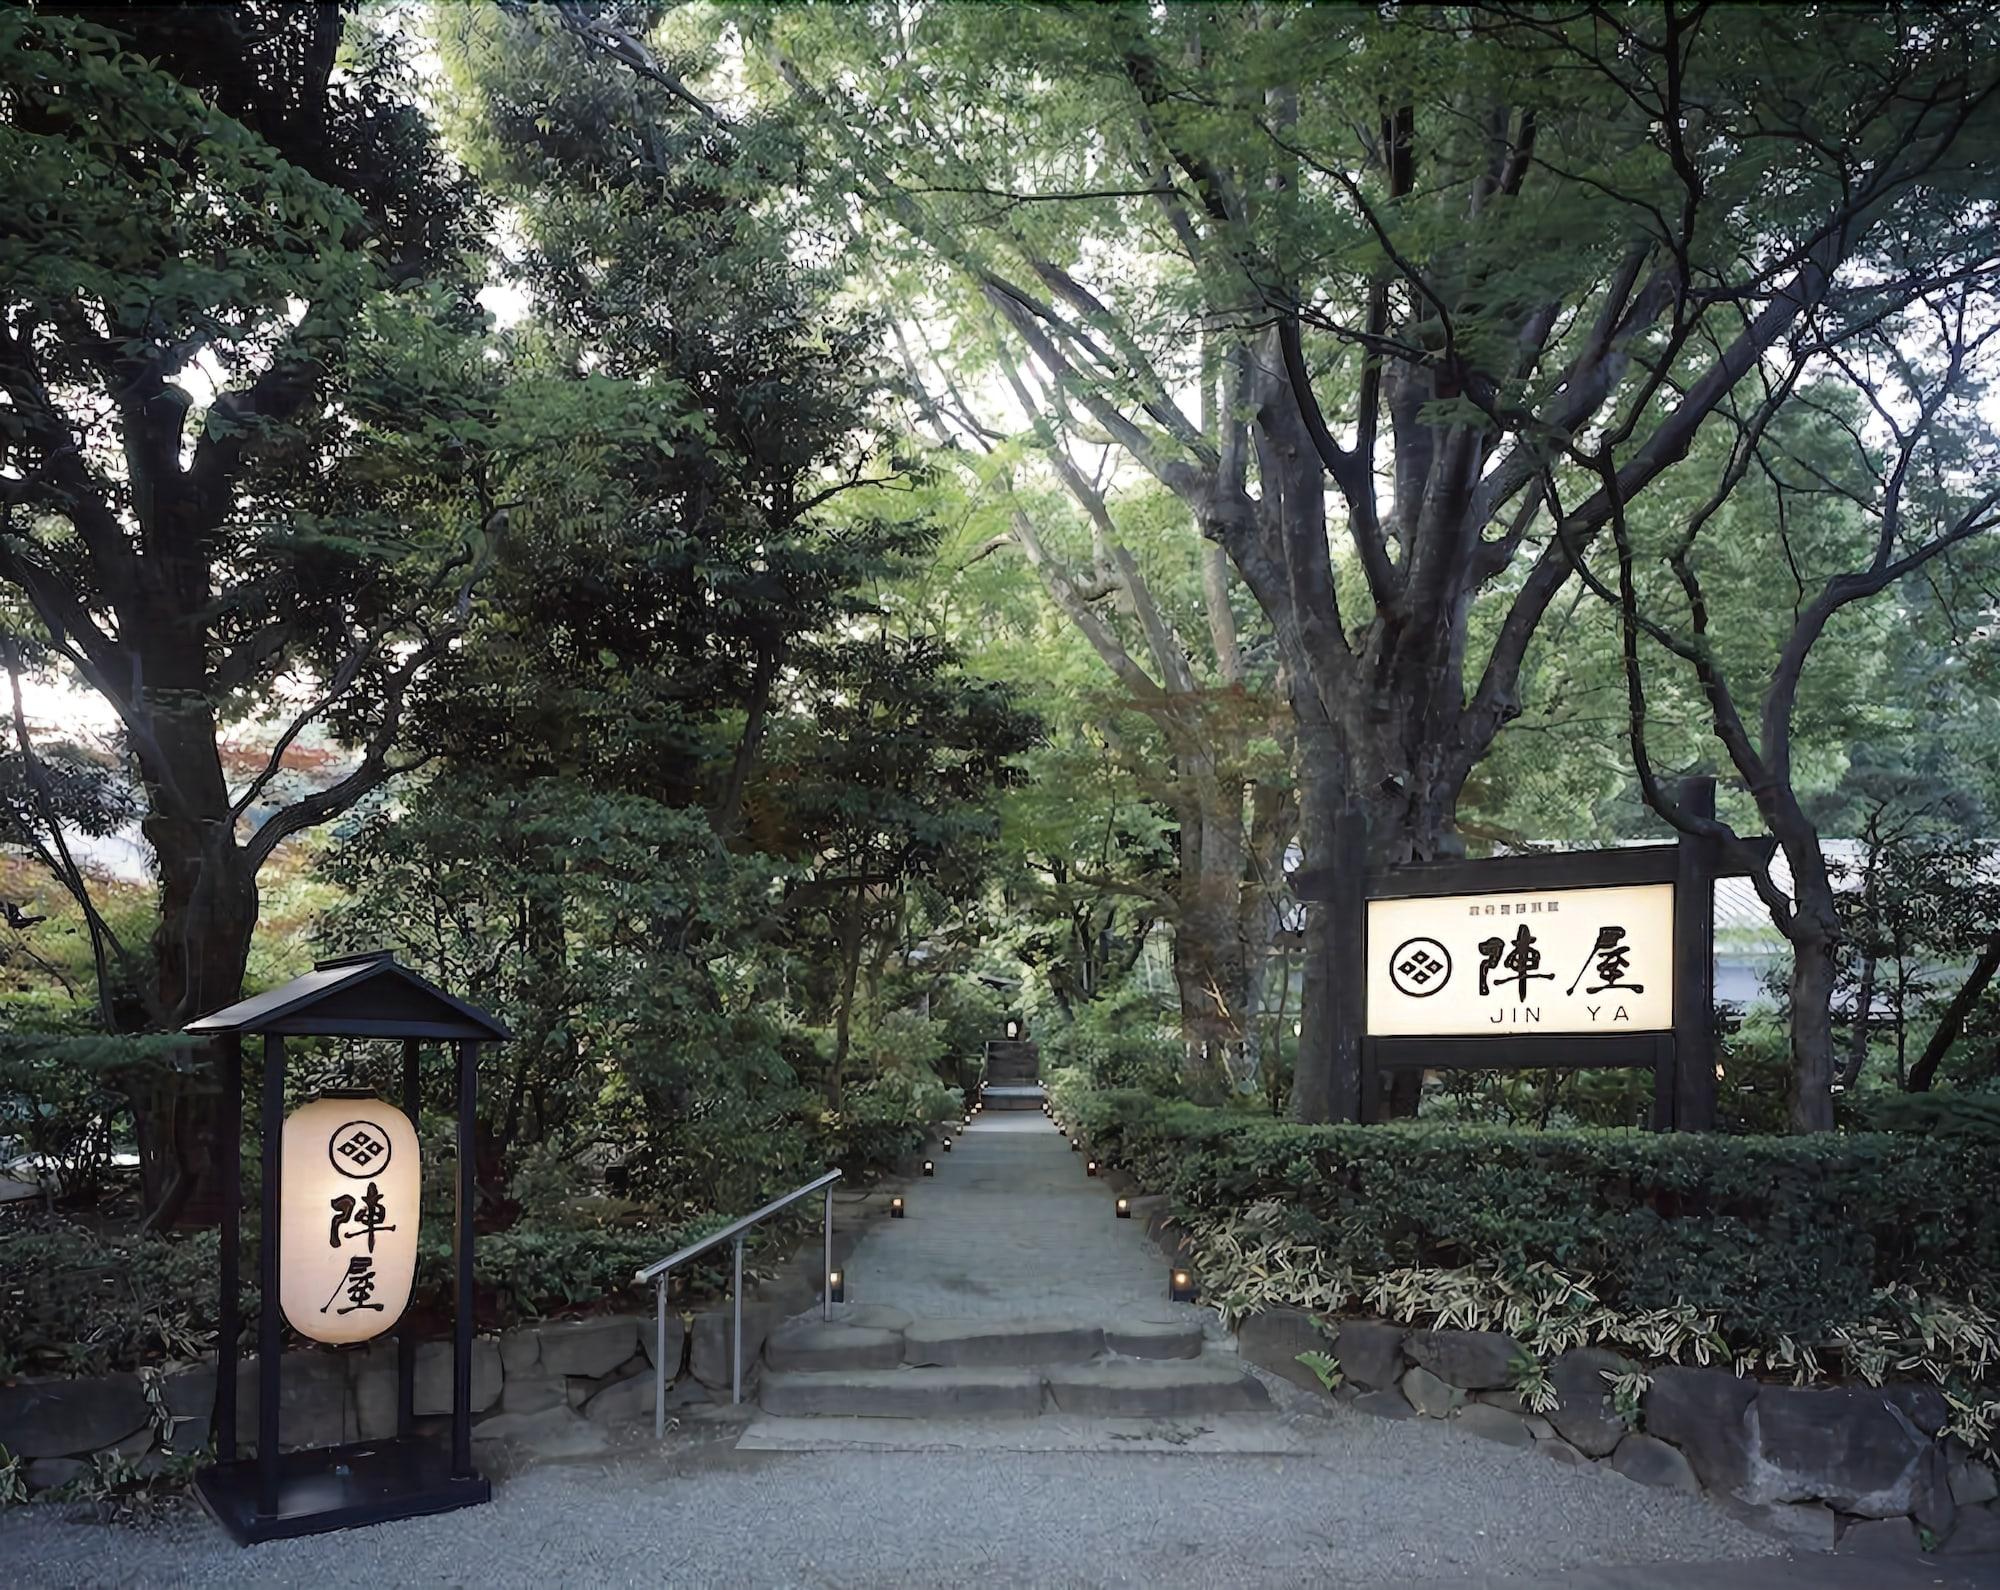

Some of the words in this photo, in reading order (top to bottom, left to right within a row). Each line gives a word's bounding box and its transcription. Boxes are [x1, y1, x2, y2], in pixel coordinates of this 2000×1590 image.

[1478, 924, 1644, 1002] 陣屋
[1490, 1007, 1540, 1024] JIN
[1587, 1006, 1630, 1022] YA
[320, 1181, 397, 1315] 陣屋
